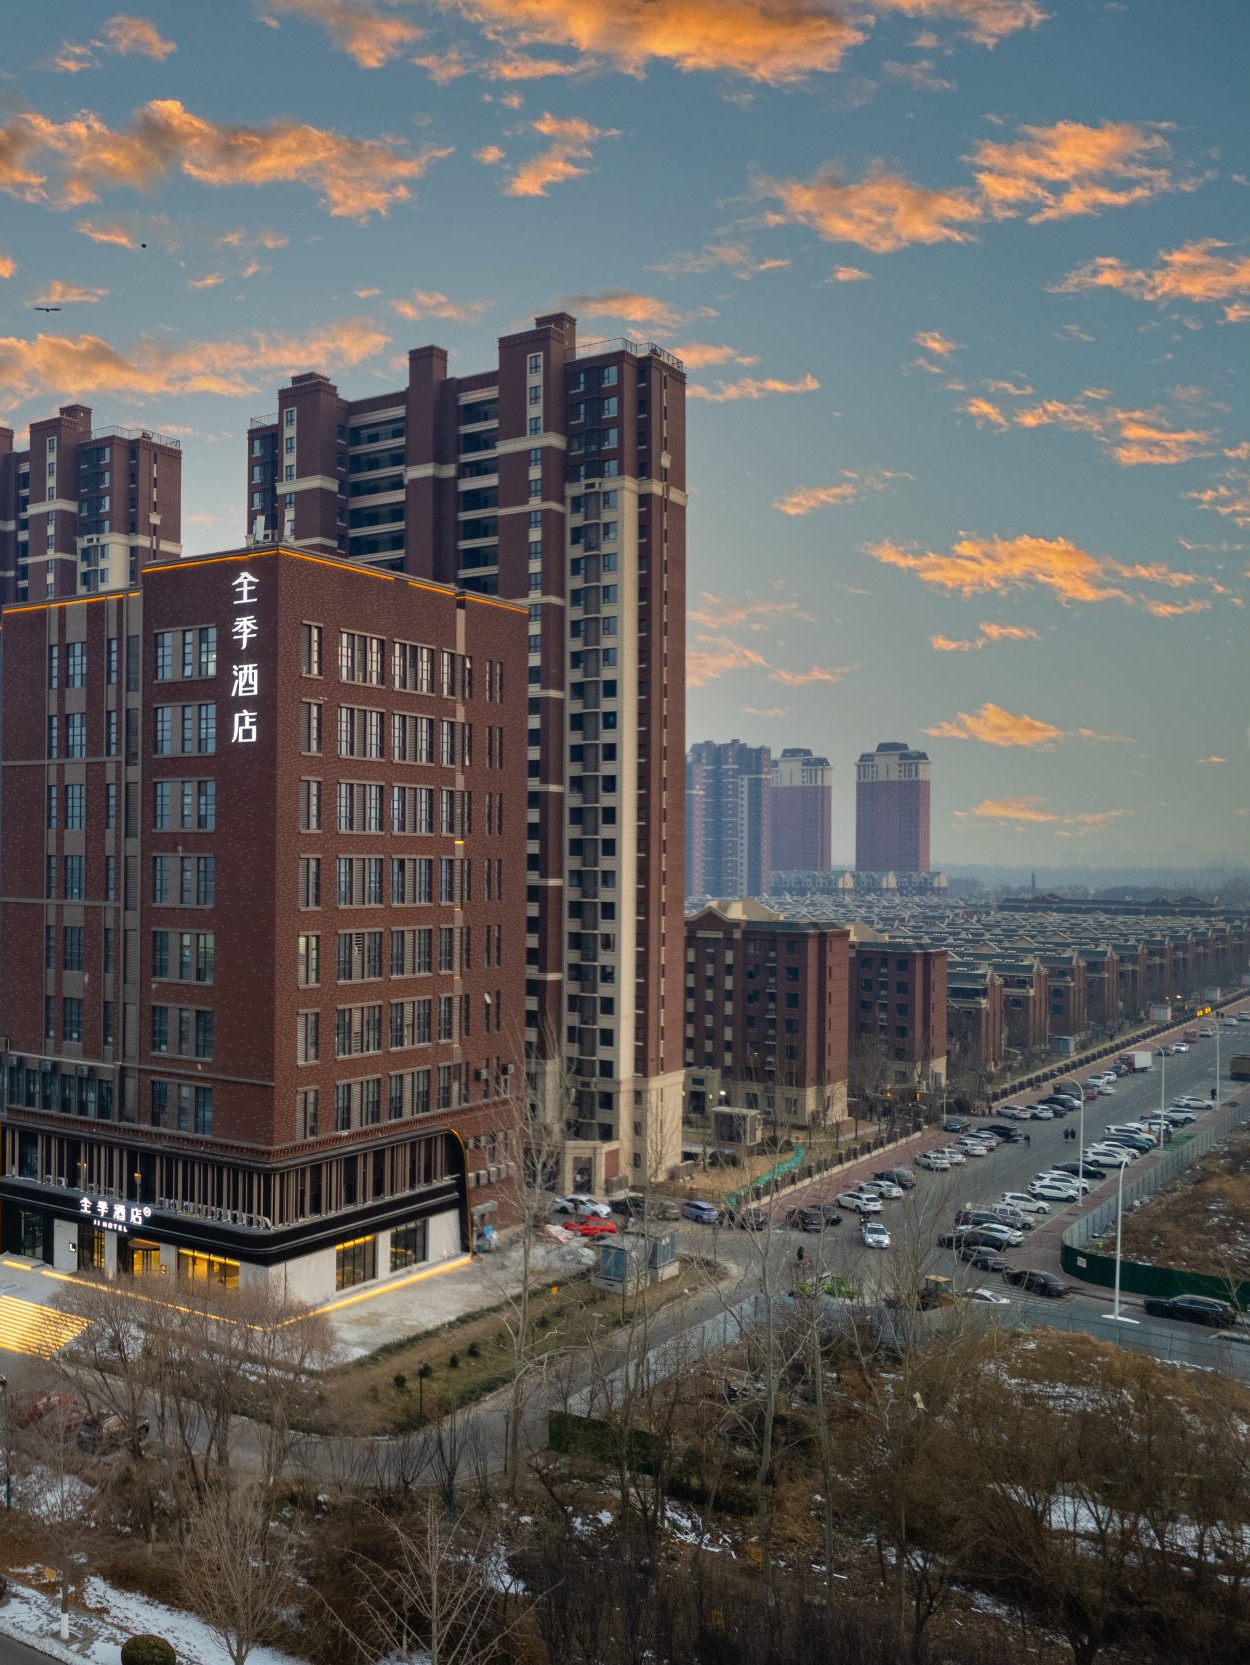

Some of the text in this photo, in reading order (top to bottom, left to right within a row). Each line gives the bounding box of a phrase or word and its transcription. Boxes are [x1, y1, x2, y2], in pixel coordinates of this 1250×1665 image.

[231, 571, 260, 743] 全季酒店
[79, 1197, 143, 1225] 全季酒店
[102, 1221, 128, 1232] HOTEL
